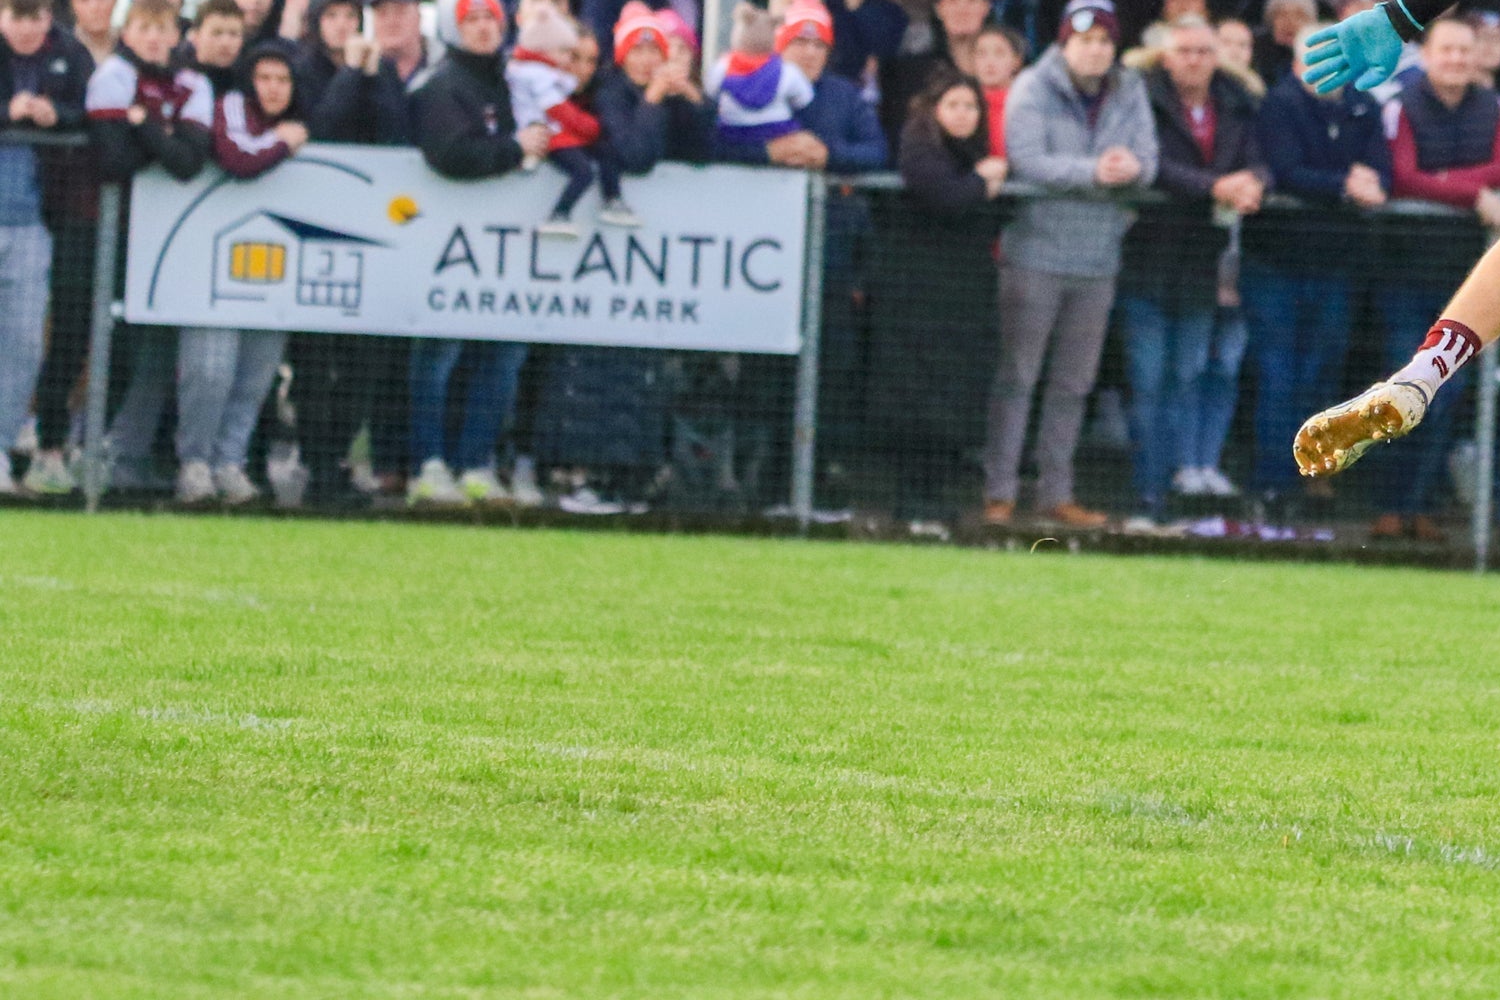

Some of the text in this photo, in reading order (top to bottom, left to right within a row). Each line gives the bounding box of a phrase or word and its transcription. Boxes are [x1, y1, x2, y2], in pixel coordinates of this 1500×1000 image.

[432, 224, 783, 293] ATLANTIC
[427, 287, 702, 322] CARAVAN PARK
